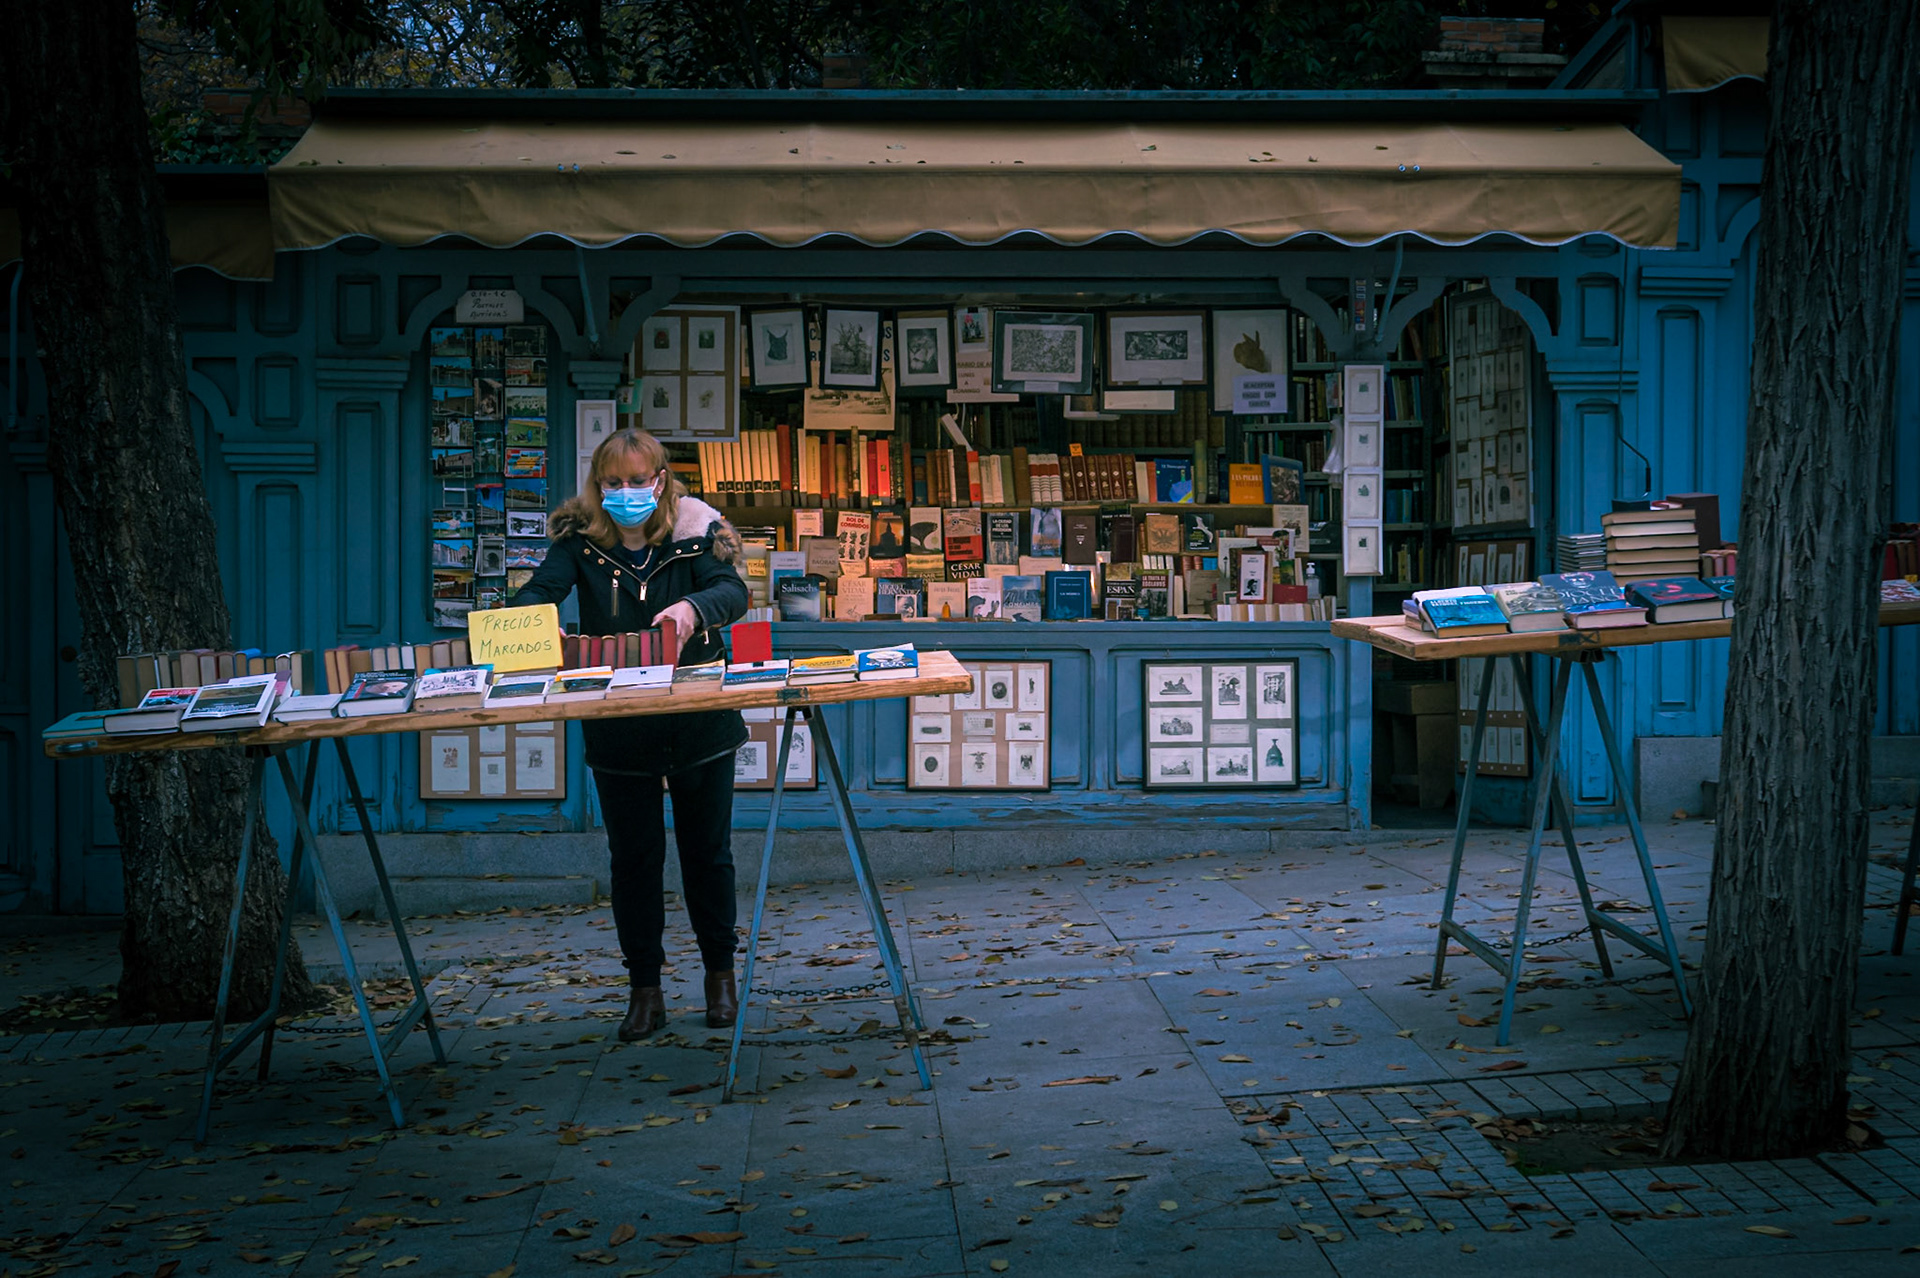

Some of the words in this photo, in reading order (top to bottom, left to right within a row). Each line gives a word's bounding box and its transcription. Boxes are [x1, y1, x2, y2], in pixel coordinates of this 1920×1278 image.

[951, 570, 982, 579] VIDAL
[781, 583, 819, 593] Salisachs
[482, 613, 543, 633] PRECIOS
[479, 639, 552, 660] MARCADOS
